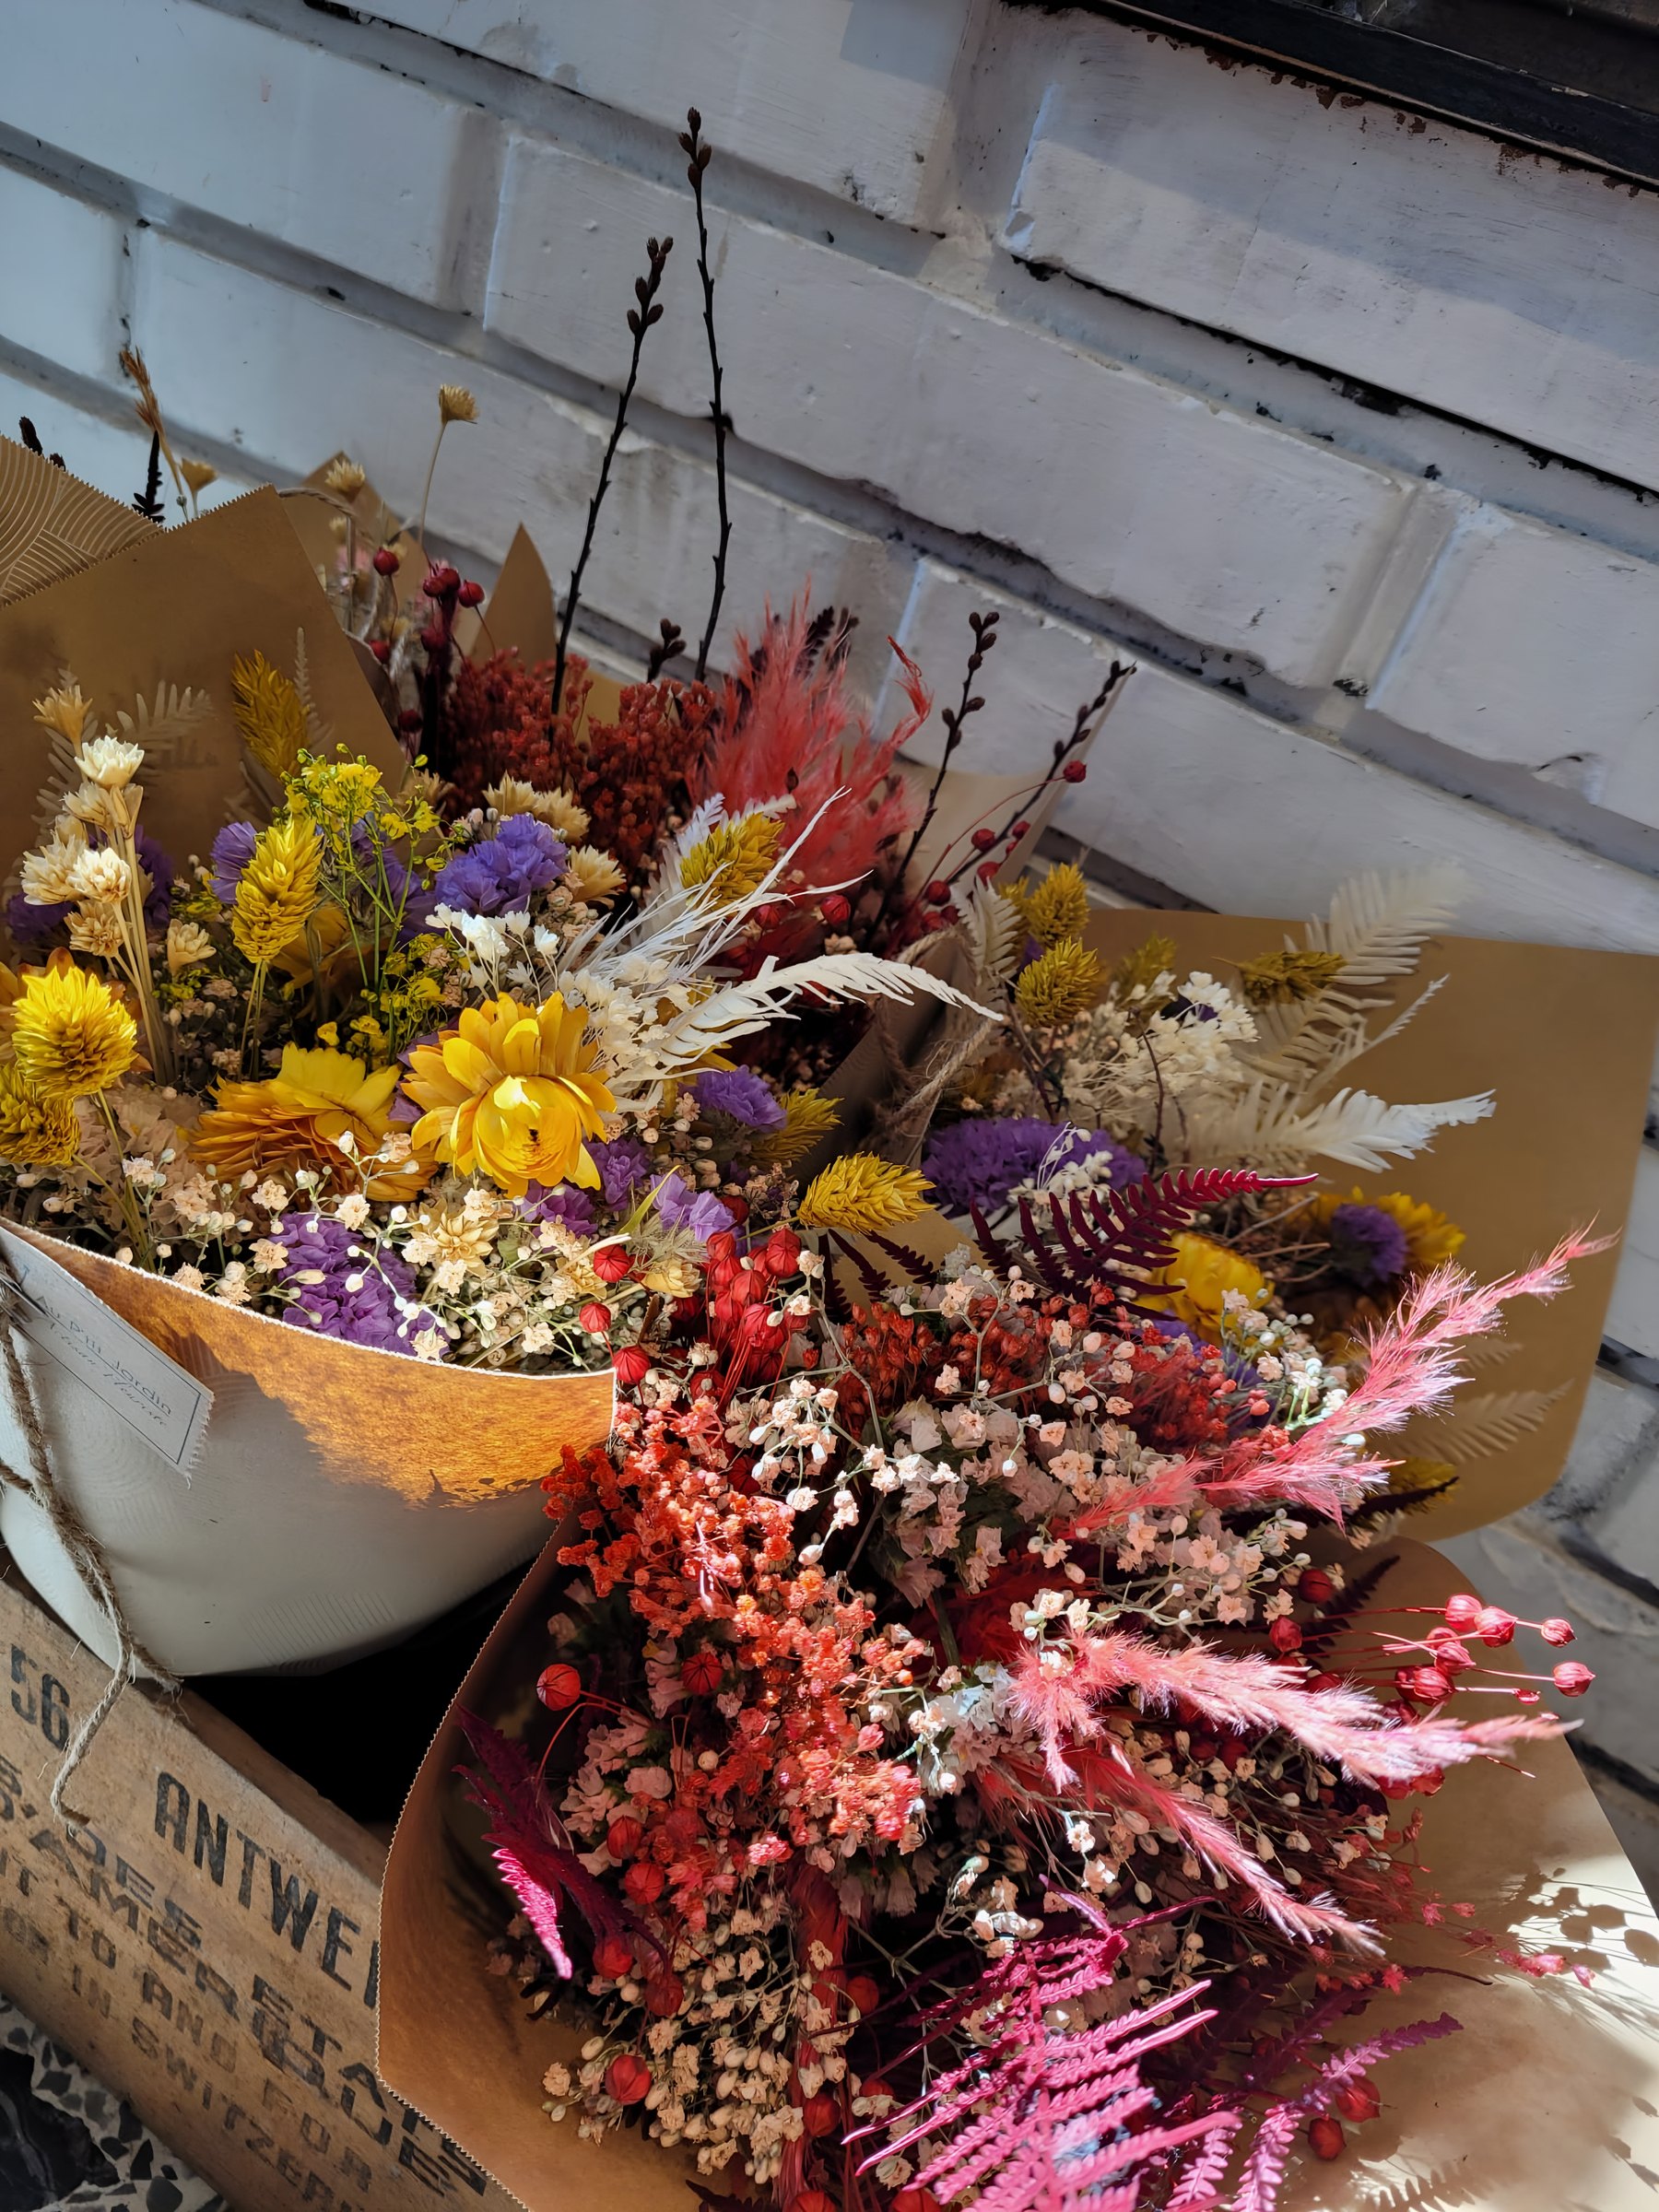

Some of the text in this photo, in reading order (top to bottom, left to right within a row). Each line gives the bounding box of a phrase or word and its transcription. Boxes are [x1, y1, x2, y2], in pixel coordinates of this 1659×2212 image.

[10, 1643, 70, 1751] 56
[131, 2017, 352, 2212] SWITZER
[143, 1970, 237, 2074] AND
[262, 2077, 372, 2193] FOR
